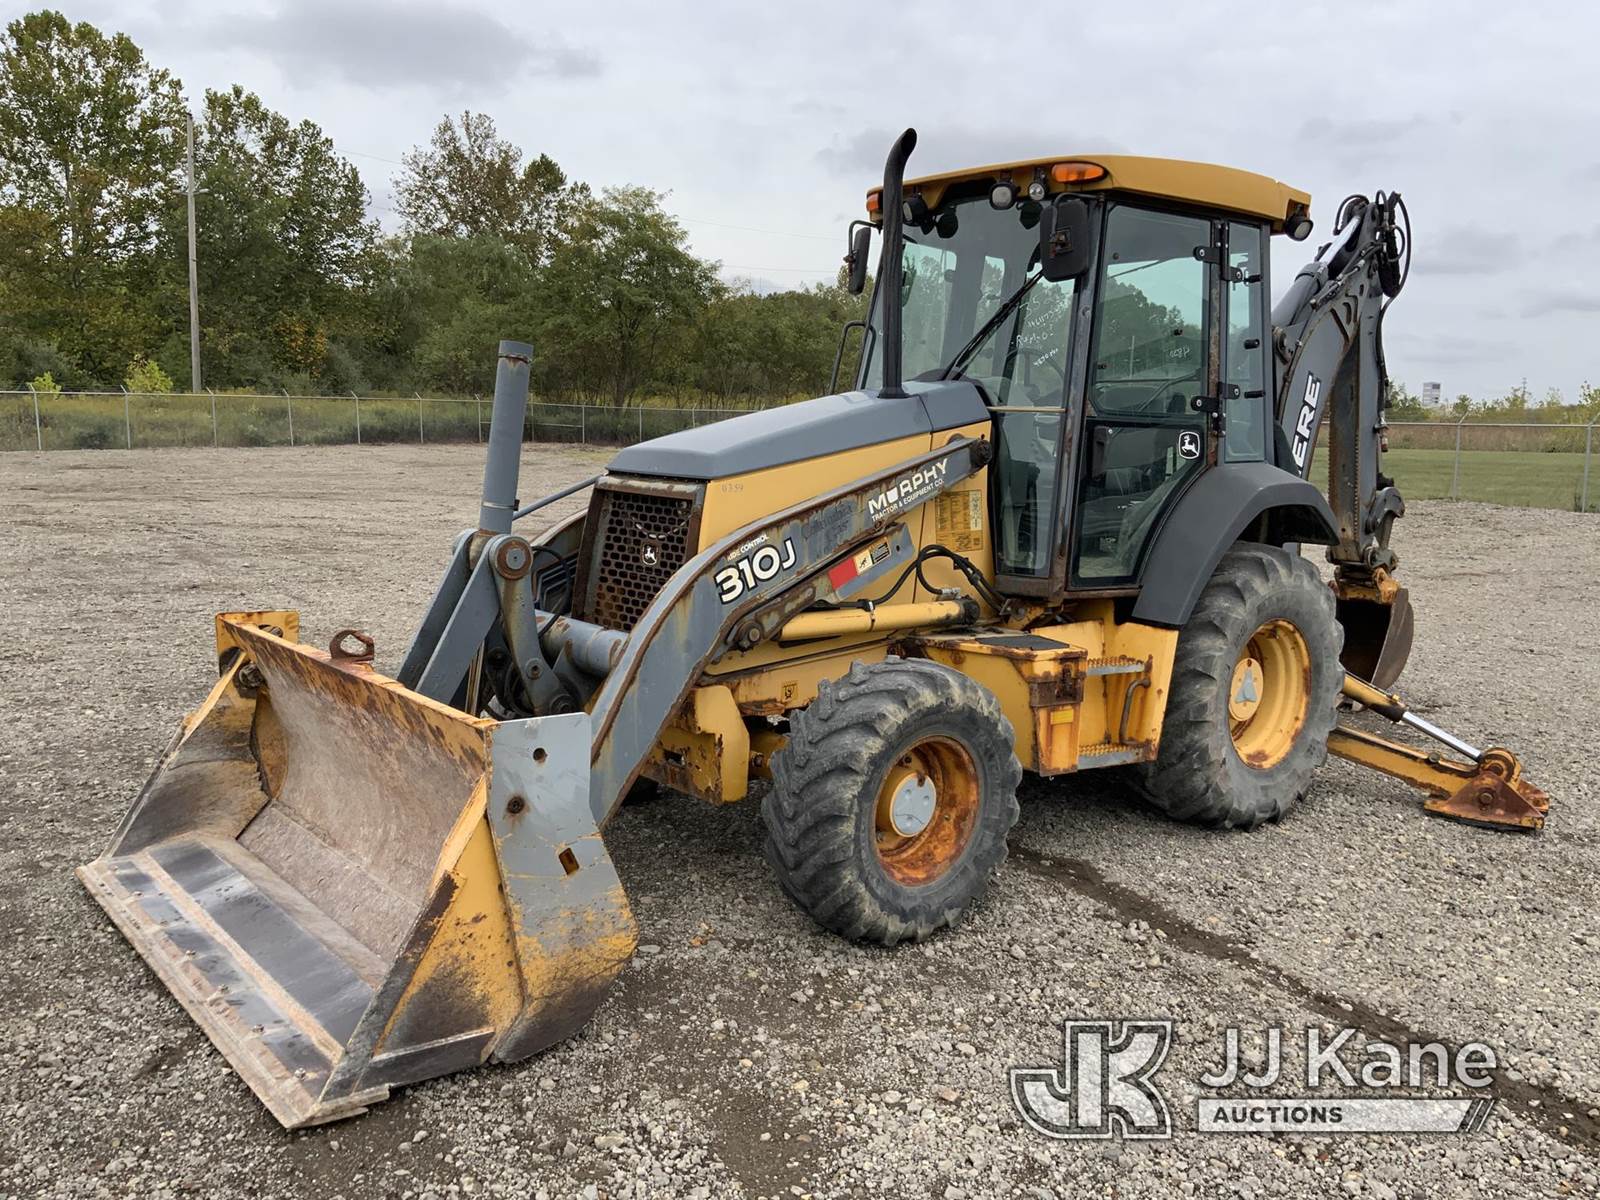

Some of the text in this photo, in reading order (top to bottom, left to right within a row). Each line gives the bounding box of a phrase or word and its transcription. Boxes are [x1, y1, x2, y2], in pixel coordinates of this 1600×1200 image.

[1292, 371, 1321, 475] ERE
[871, 504, 899, 522] TRACTOR
[903, 483, 934, 505] EQUIPMENT
[740, 533, 769, 553] CONTROL
[713, 536, 797, 605] 310J
